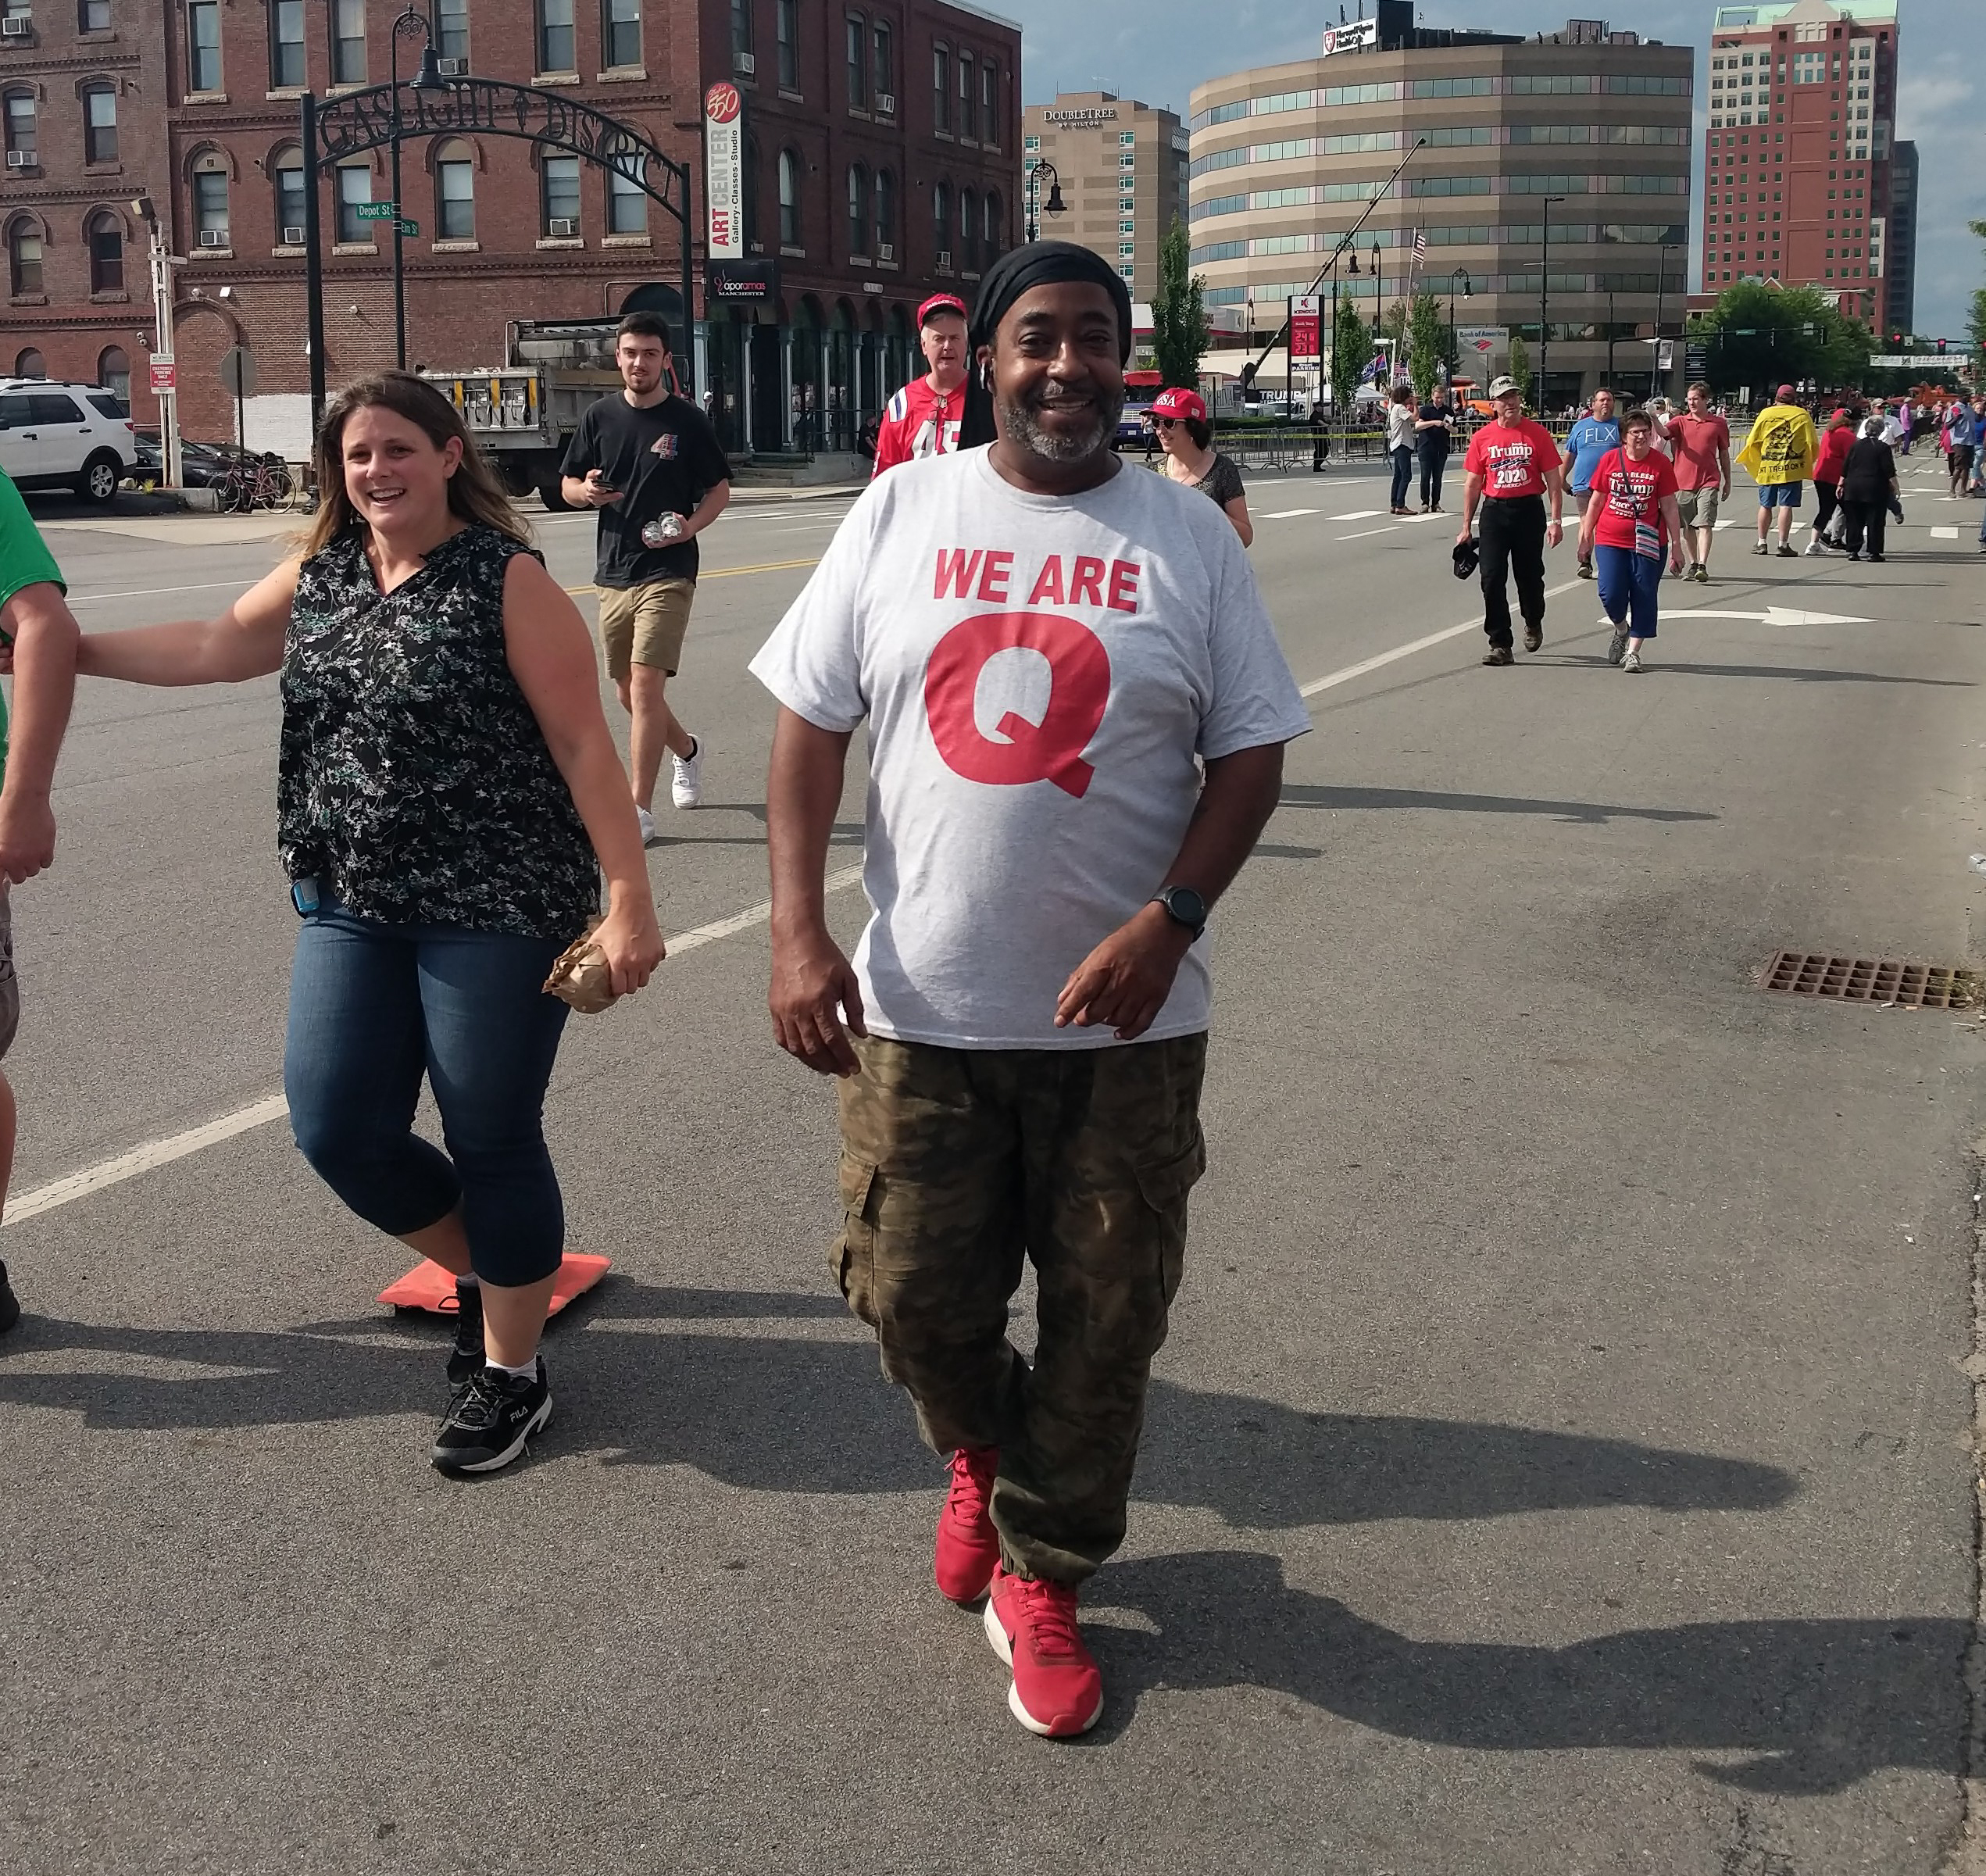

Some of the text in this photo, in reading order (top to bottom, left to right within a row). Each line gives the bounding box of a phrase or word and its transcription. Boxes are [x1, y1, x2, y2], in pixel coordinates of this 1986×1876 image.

[707, 90, 739, 120] 550
[710, 129, 730, 247] ART CENTER
[730, 166, 739, 205] Classes
[359, 204, 391, 218] Depot St
[401, 222, 418, 234] Elm St
[730, 209, 741, 244] Gallery
[1156, 394, 1177, 408] USA
[1259, 390, 1302, 401] TRUMP
[912, 420, 963, 461] 45
[1584, 427, 1616, 444] FLX
[1487, 445, 1533, 459] Trump
[1497, 468, 1527, 484] 2020
[1630, 471, 1656, 481] BLESS
[1609, 478, 1655, 496] Trump
[934, 549, 1141, 614] WE ARE
[924, 612, 1111, 799] Q
[509, 1406, 529, 1423] FILA
